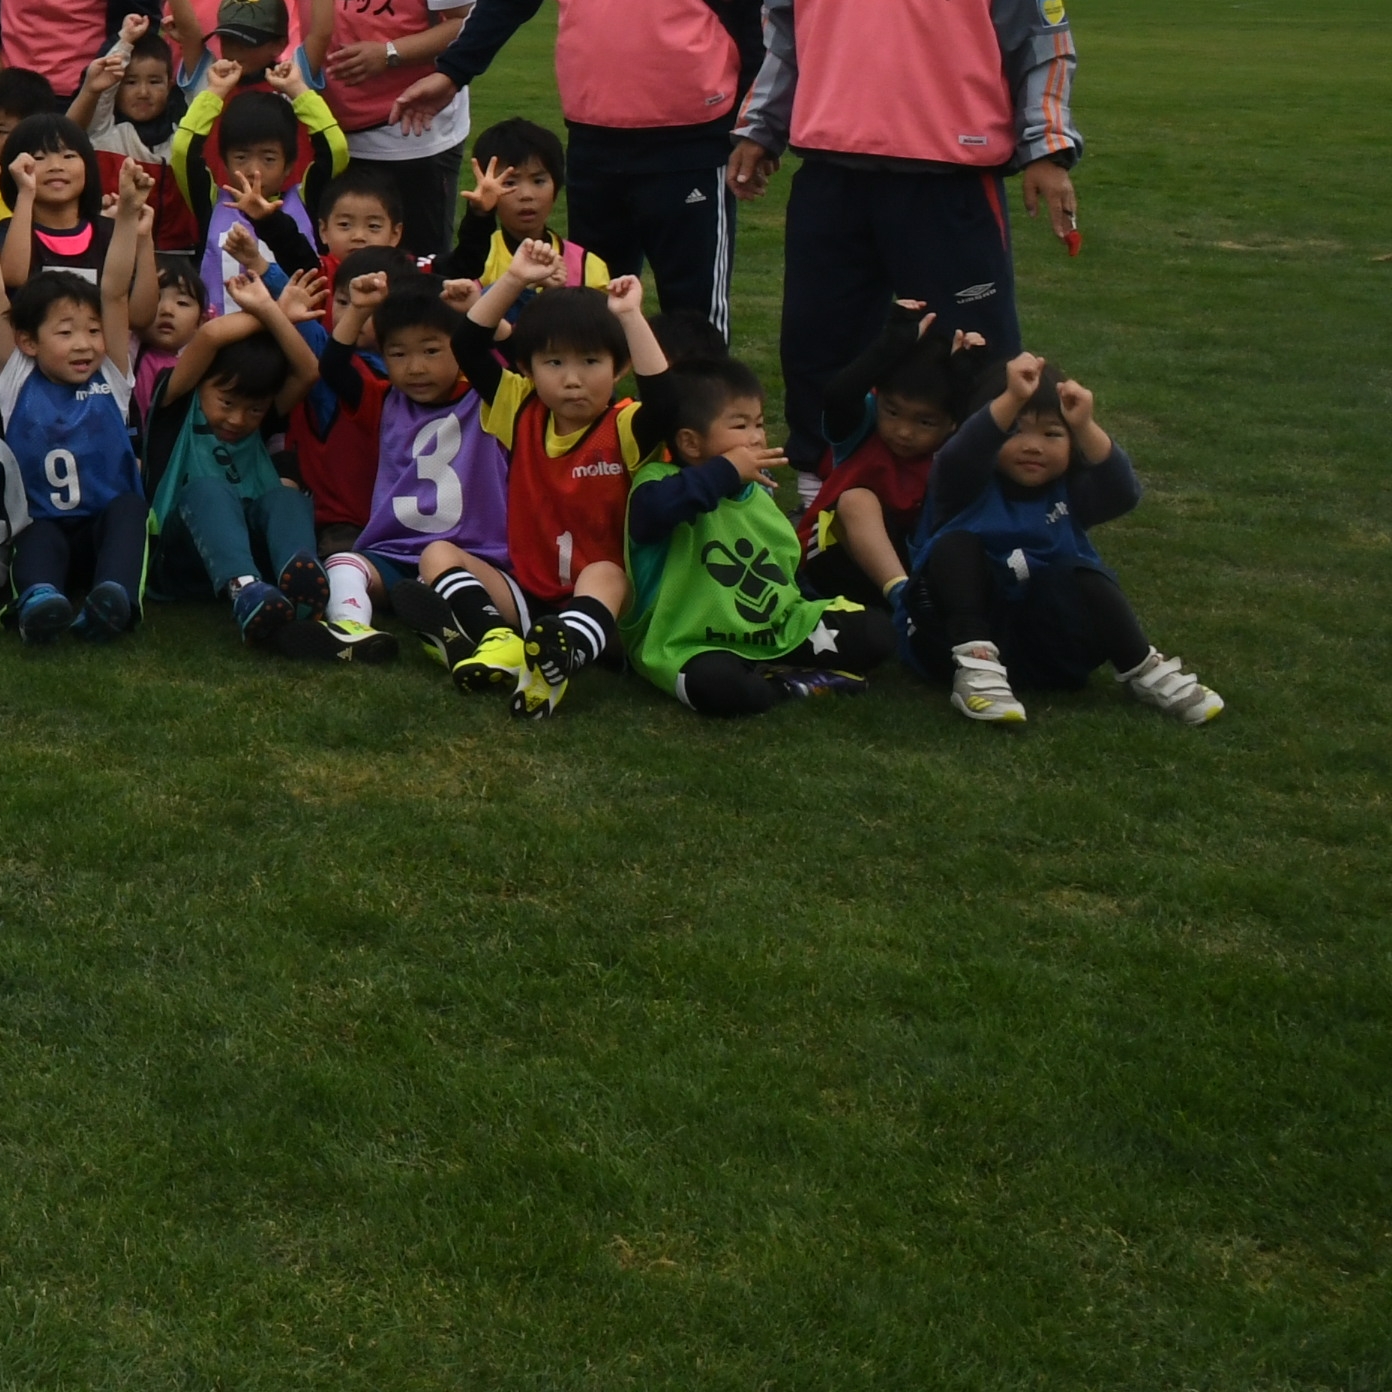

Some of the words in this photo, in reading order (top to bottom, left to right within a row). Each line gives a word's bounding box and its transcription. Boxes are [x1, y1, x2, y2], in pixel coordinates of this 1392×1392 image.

[44, 448, 81, 510] 9
[392, 412, 463, 533] 3
[556, 530, 574, 586] 1
